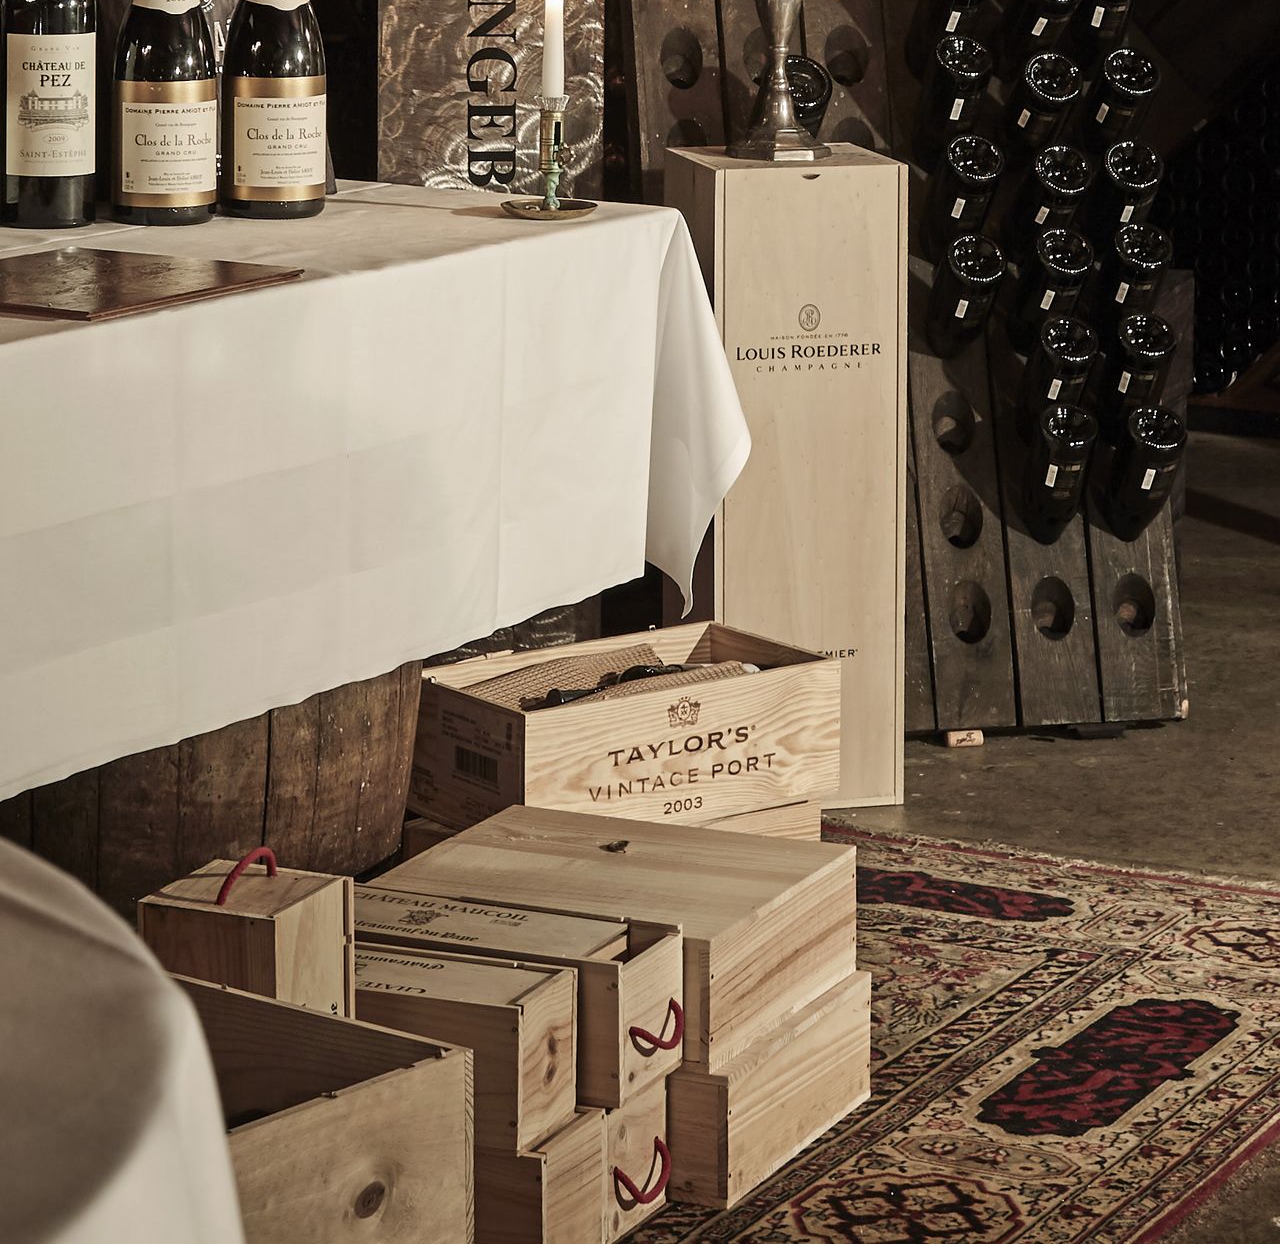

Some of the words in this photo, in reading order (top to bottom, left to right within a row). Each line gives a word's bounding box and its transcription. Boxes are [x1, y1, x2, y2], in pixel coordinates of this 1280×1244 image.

[22, 60, 71, 71] CHÂTEAU
[74, 61, 86, 70] DE
[40, 74, 71, 87] PEZ
[135, 134, 157, 146] Clos
[160, 134, 172, 146] de
[175, 134, 183, 146] la
[188, 133, 212, 146] Roche
[247, 128, 269, 140] Clos
[272, 129, 284, 140] de
[287, 129, 295, 140] la
[297, 127, 322, 140] Roche
[737, 346, 786, 361] LOUIS
[791, 343, 881, 359] ROEDERER
[756, 361, 862, 372] CHAMPAGNE
[608, 726, 750, 767] TAYLOR'S
[589, 768, 699, 802] VINTAGE
[711, 753, 776, 779] PORT
[663, 797, 703, 815] 2003
[439, 904, 529, 922] MAUCOIL
